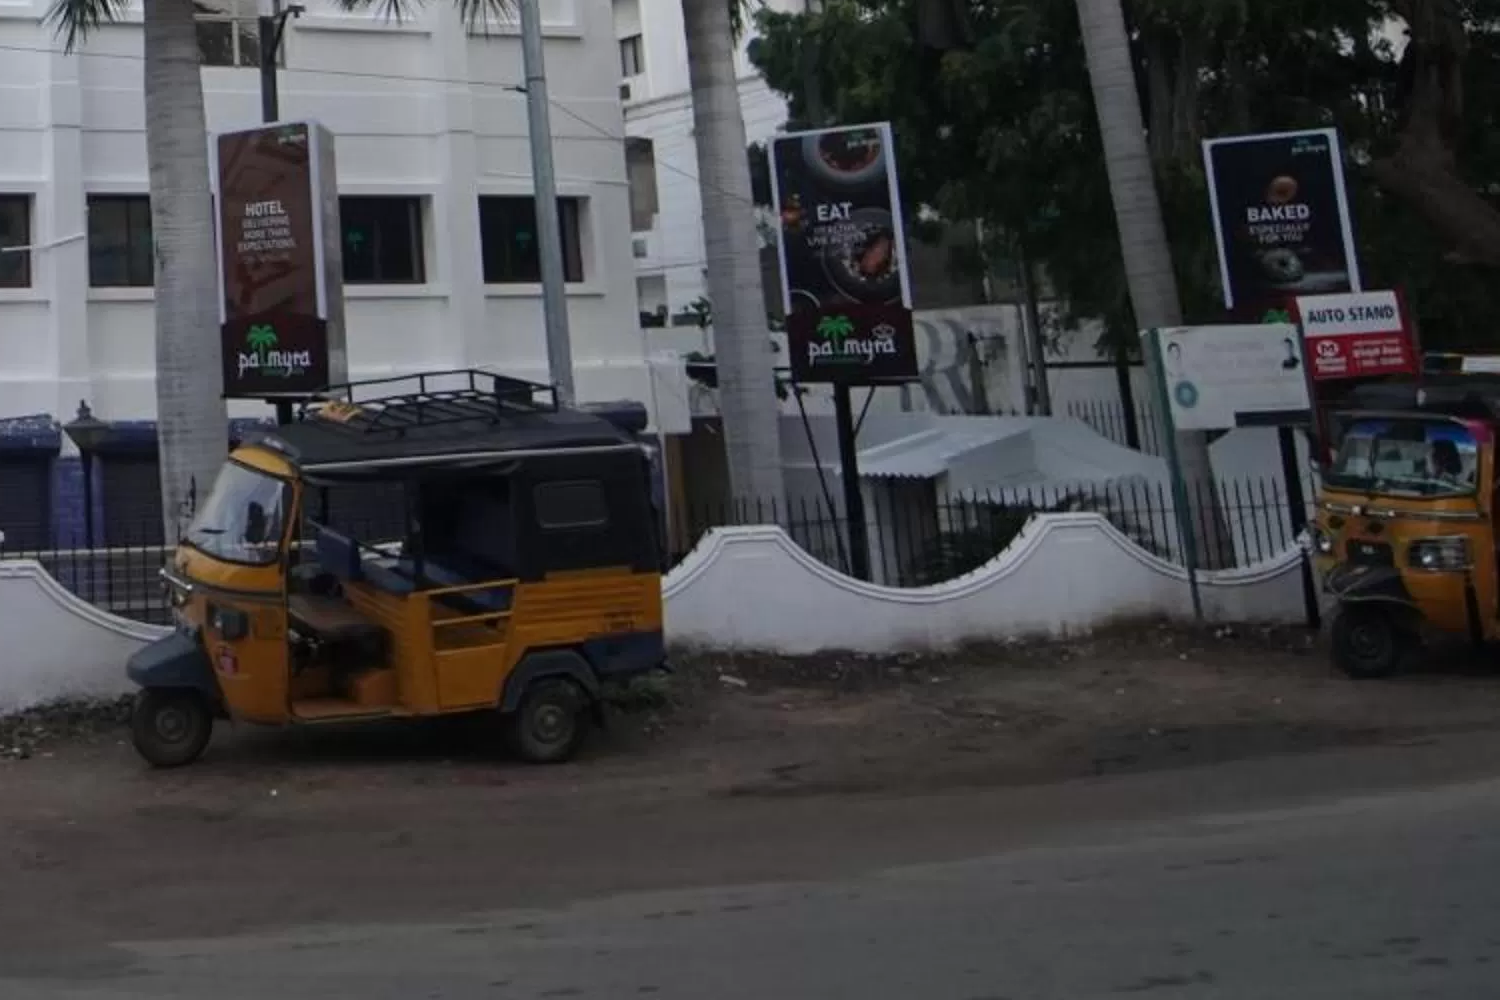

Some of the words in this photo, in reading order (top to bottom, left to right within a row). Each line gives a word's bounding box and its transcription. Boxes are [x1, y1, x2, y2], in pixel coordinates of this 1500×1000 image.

[245, 200, 286, 217] HOTEL
[817, 202, 852, 222] EAT
[1247, 203, 1310, 222] BAKED
[1308, 308, 1345, 324] AUTO
[1348, 304, 1395, 321] STAND
